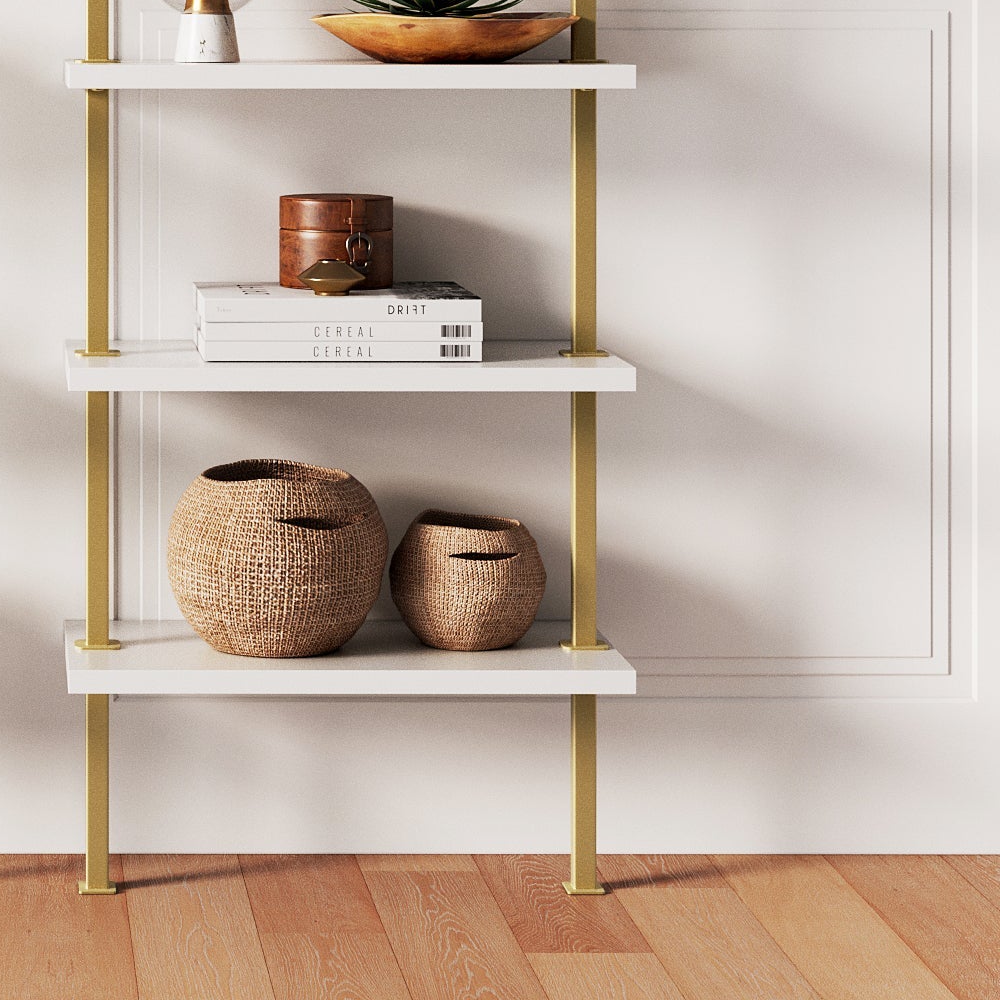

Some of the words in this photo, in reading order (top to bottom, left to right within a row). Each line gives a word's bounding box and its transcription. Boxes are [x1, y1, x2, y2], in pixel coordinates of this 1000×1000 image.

[387, 304, 427, 315] DRIFT
[314, 326, 374, 338] CEREAL
[313, 346, 373, 358] CEREAL
